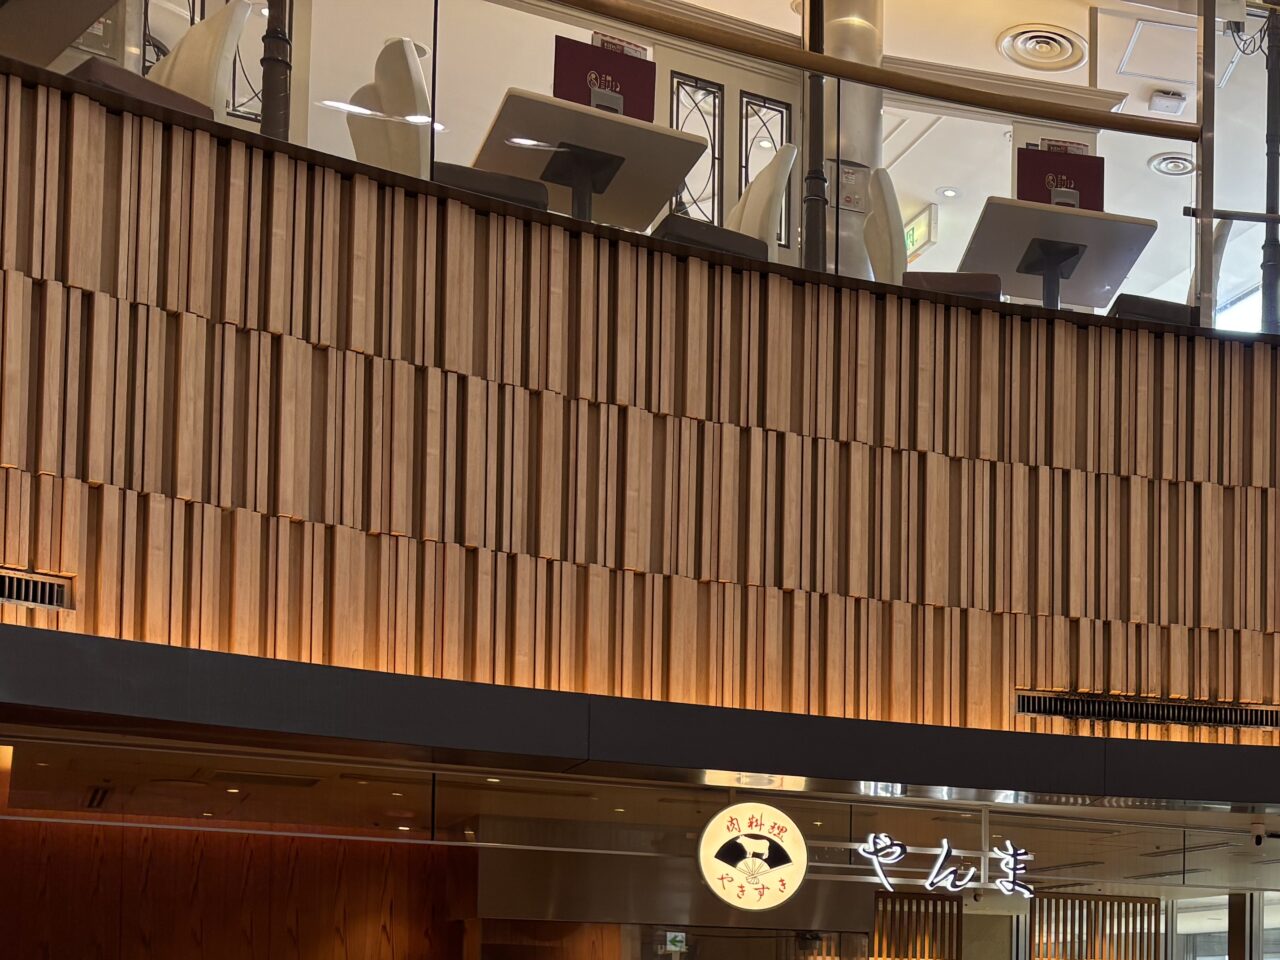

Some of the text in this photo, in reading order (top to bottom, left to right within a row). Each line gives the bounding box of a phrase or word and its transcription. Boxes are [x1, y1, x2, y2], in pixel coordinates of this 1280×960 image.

[727, 814, 788, 842] 肉料理
[858, 833, 1035, 898] やんま
[716, 873, 787, 902] やきすき
